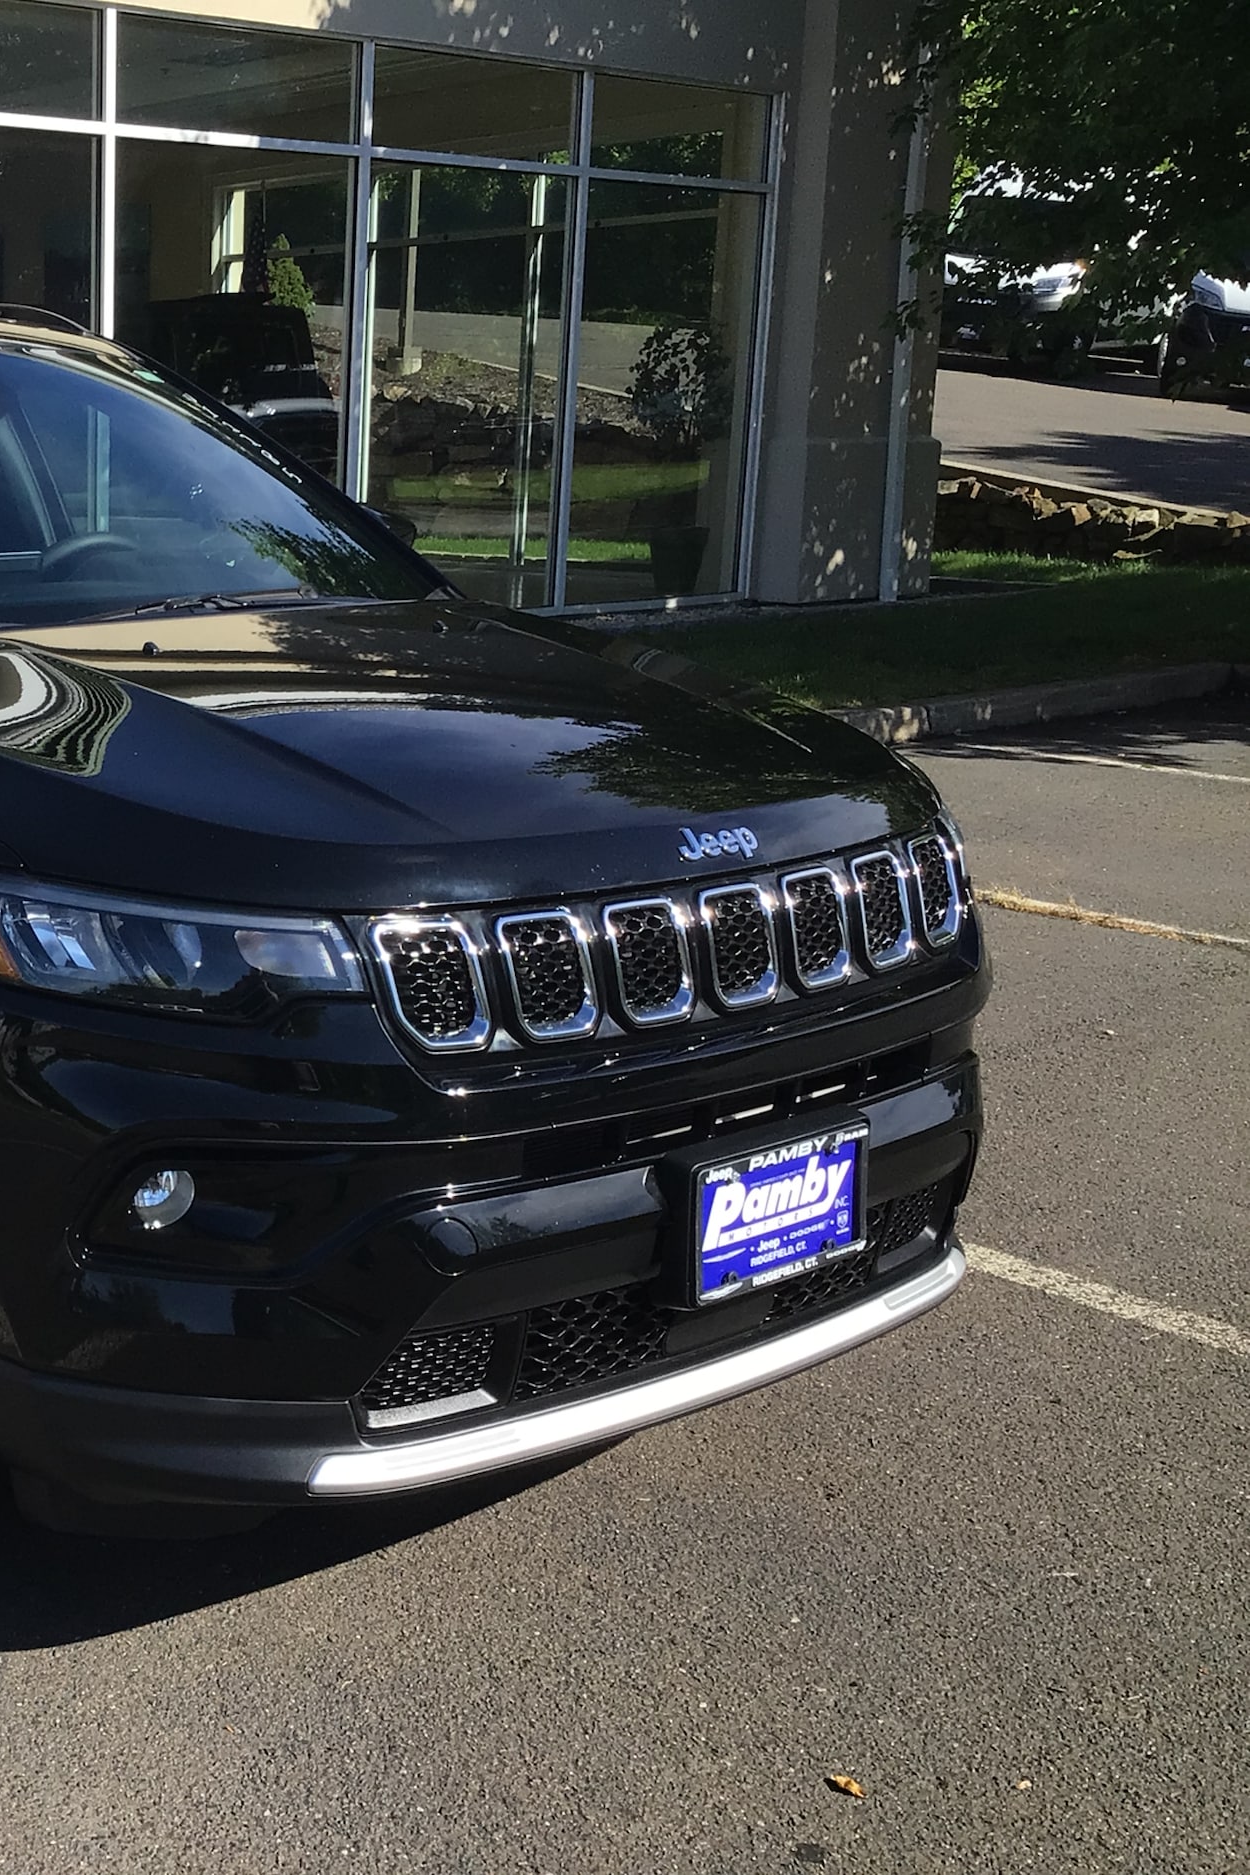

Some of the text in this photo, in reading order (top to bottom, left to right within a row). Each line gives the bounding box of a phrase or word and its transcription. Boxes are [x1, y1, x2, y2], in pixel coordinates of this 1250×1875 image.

[677, 826, 759, 861] Jeep
[748, 1136, 829, 1172] PAMBY
[705, 1167, 733, 1184] Jeep
[702, 1155, 852, 1252] Pamby
[757, 1238, 781, 1253] Jeep
